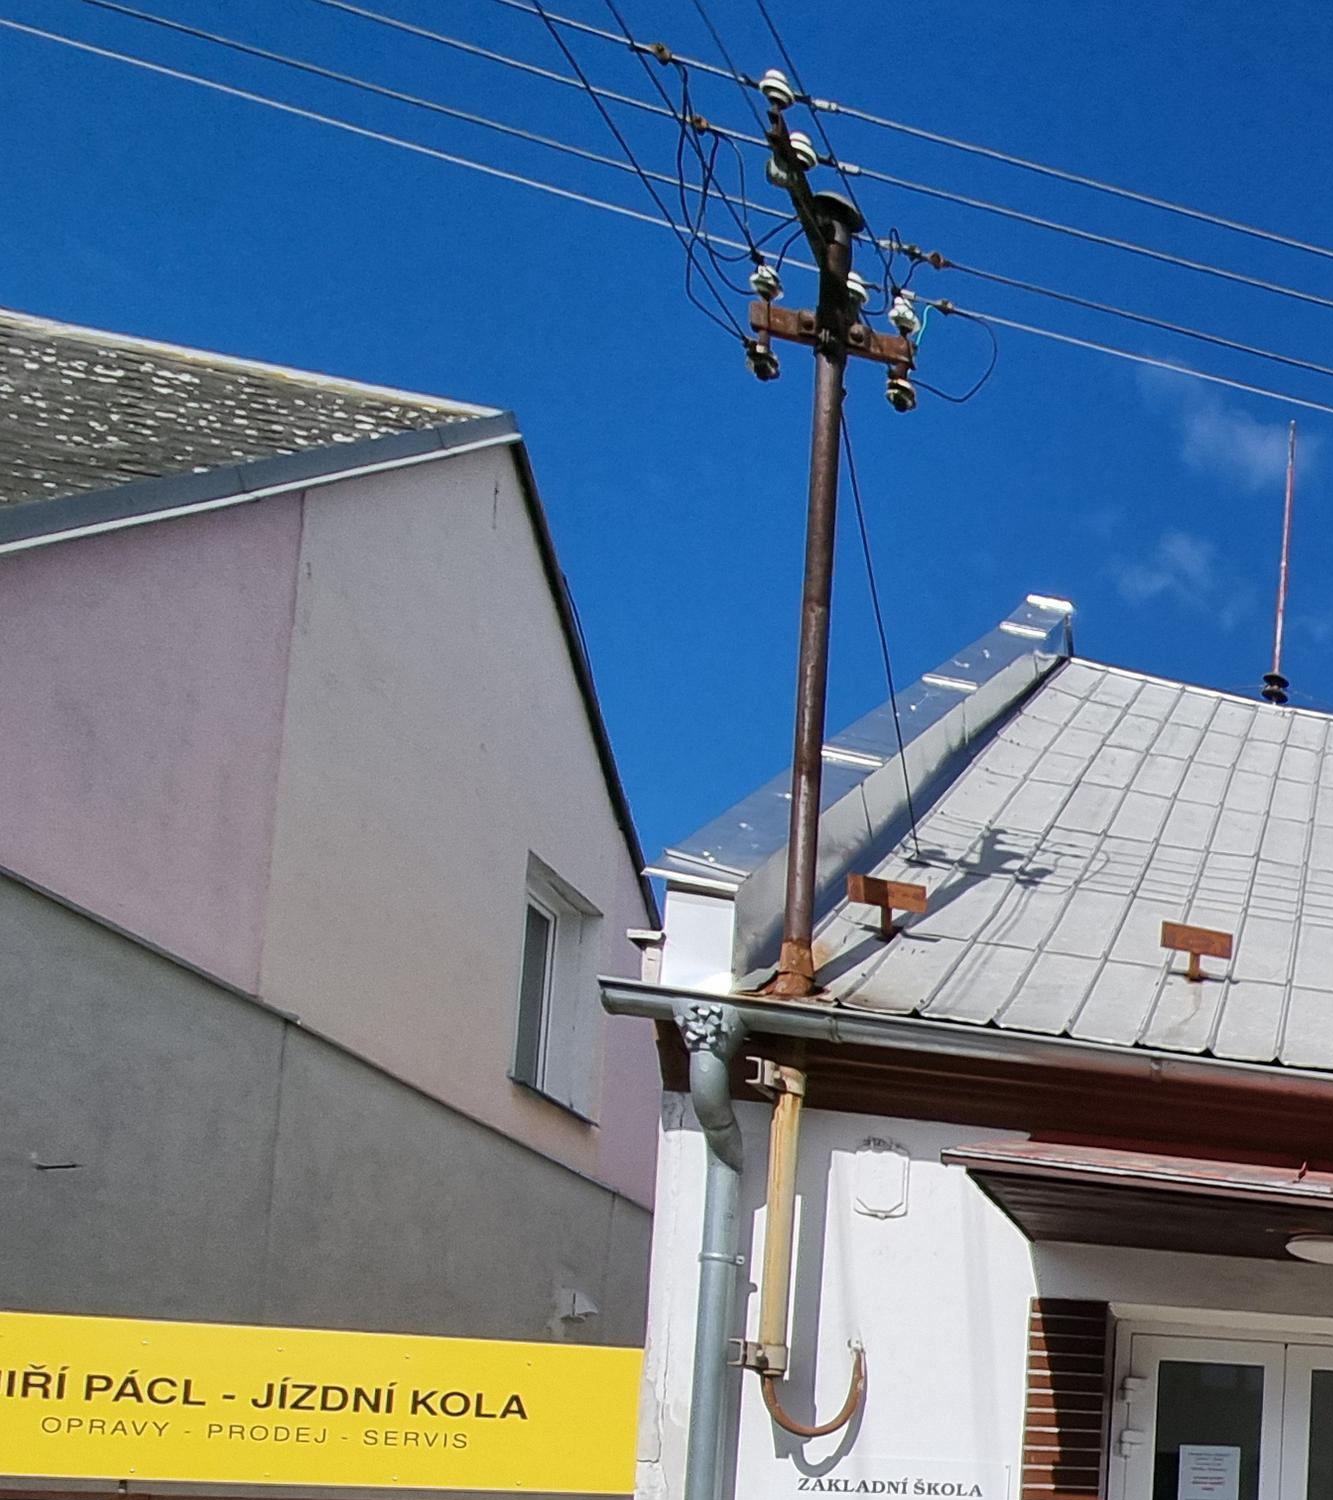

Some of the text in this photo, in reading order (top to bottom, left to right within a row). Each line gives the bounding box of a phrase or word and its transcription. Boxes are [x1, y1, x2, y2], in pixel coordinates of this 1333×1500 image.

[0, 1363, 71, 1400] IŘÍ
[84, 1368, 207, 1407] PÁCL
[251, 1376, 399, 1415] JÍZDNÍ
[410, 1389, 529, 1421] KOLA
[41, 1416, 171, 1437] OPRAVY
[208, 1423, 327, 1444] PRODEJ
[363, 1429, 468, 1449] SERVIS
[913, 1478, 983, 1497] ŠKOLA
